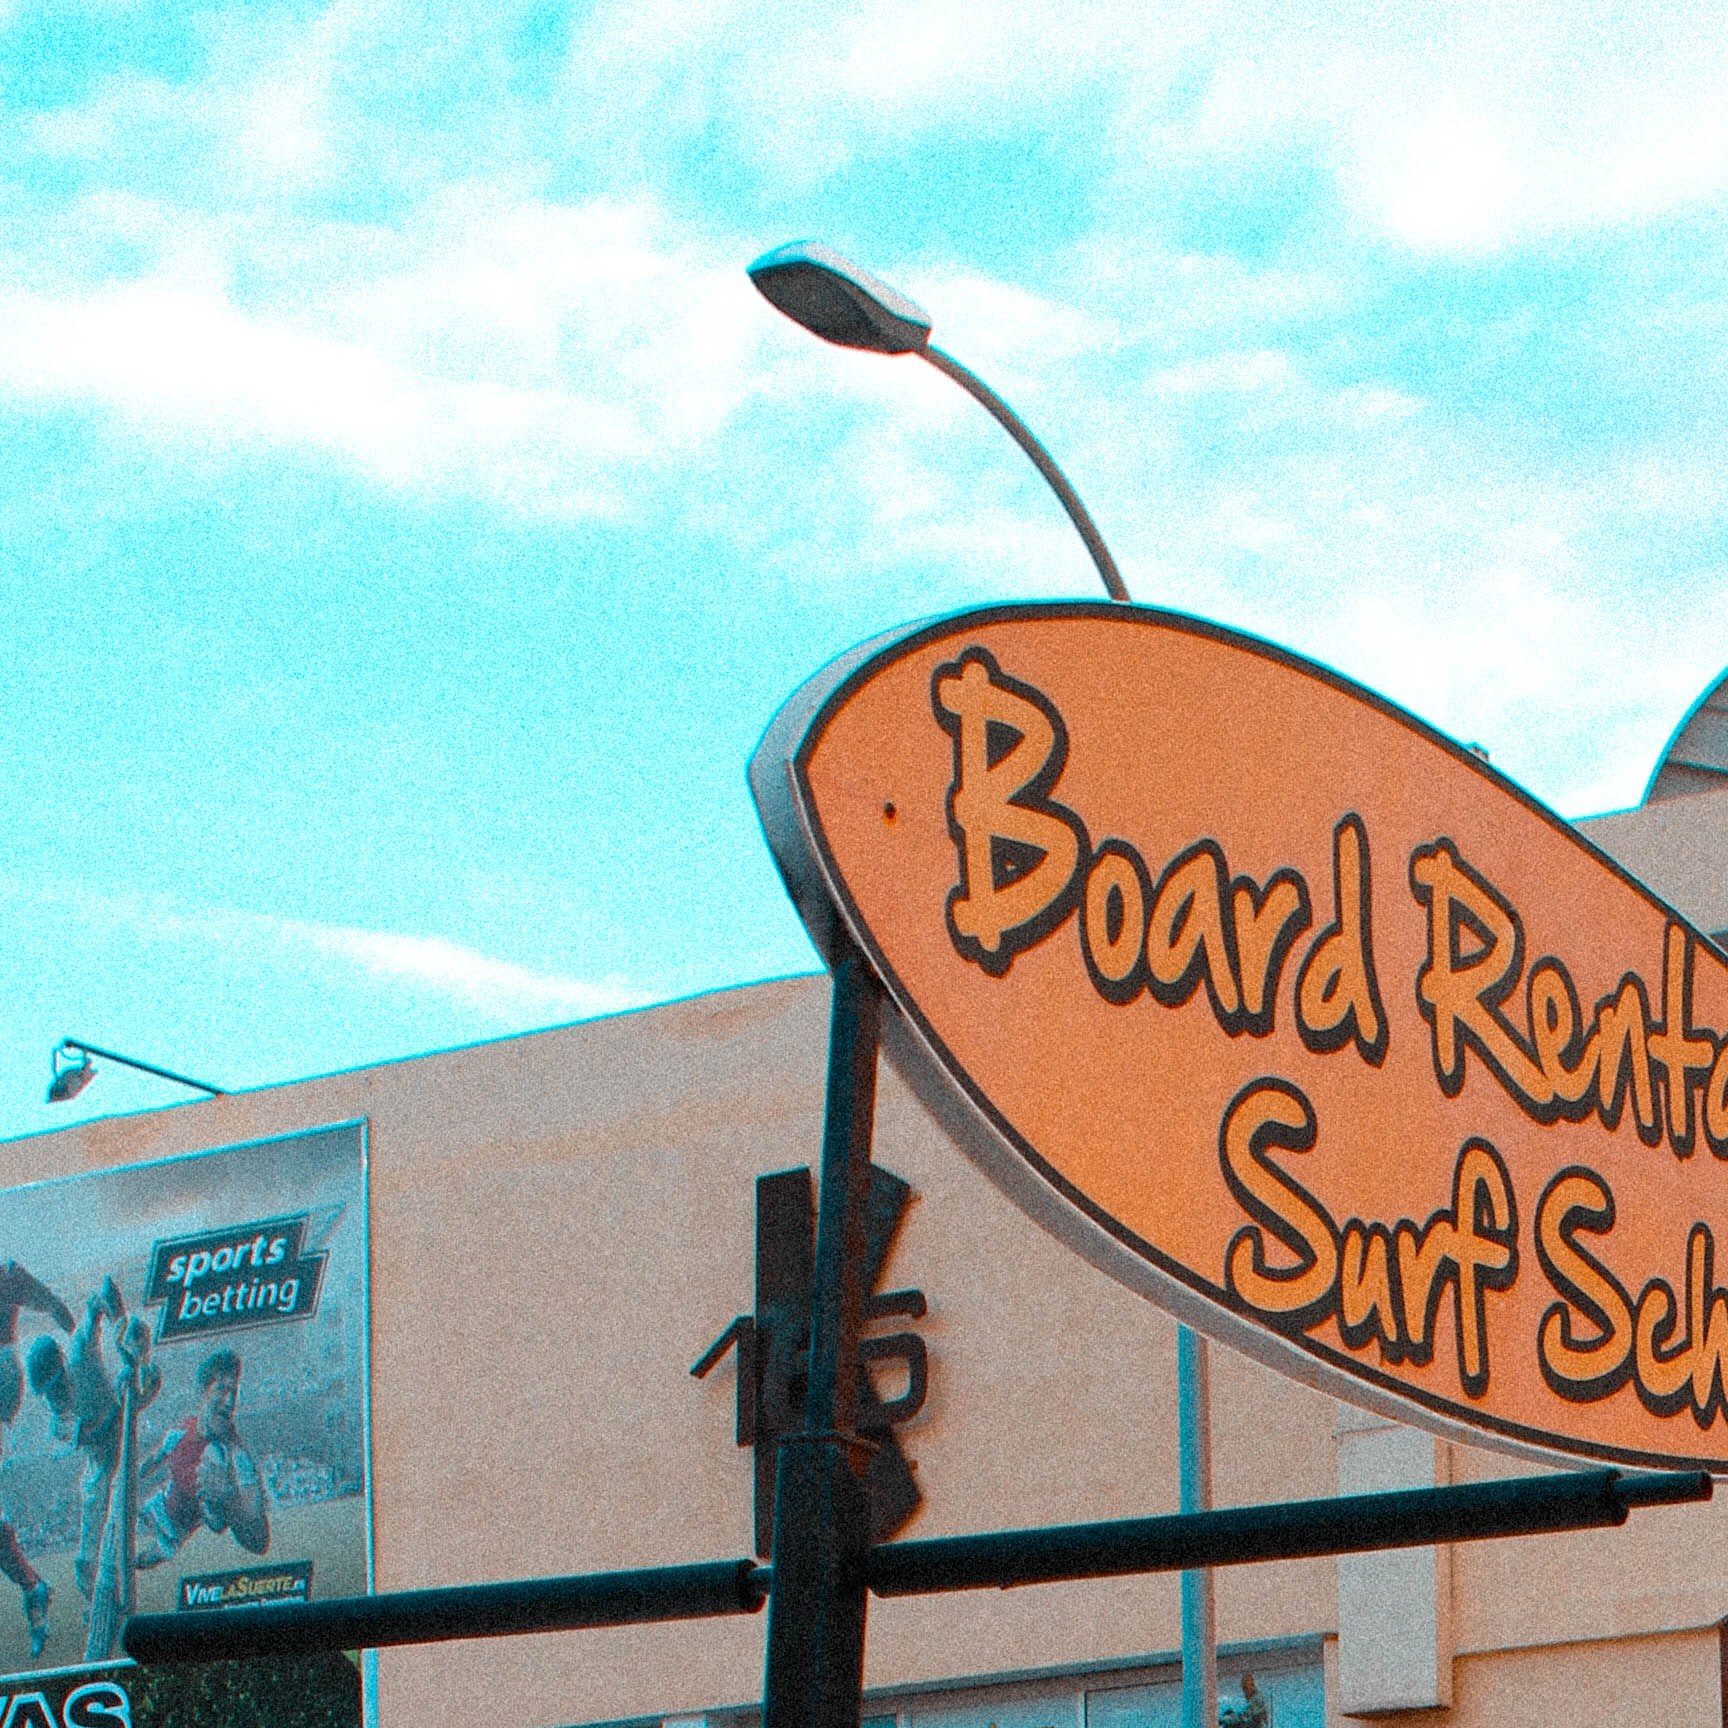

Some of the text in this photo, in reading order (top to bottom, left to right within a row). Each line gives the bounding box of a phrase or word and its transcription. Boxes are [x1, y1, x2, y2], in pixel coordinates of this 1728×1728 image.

[931, 645, 1389, 1068] Board
[166, 1235, 288, 1287] sports
[179, 1277, 301, 1321] betting
[1219, 1075, 1519, 1397] Surf
